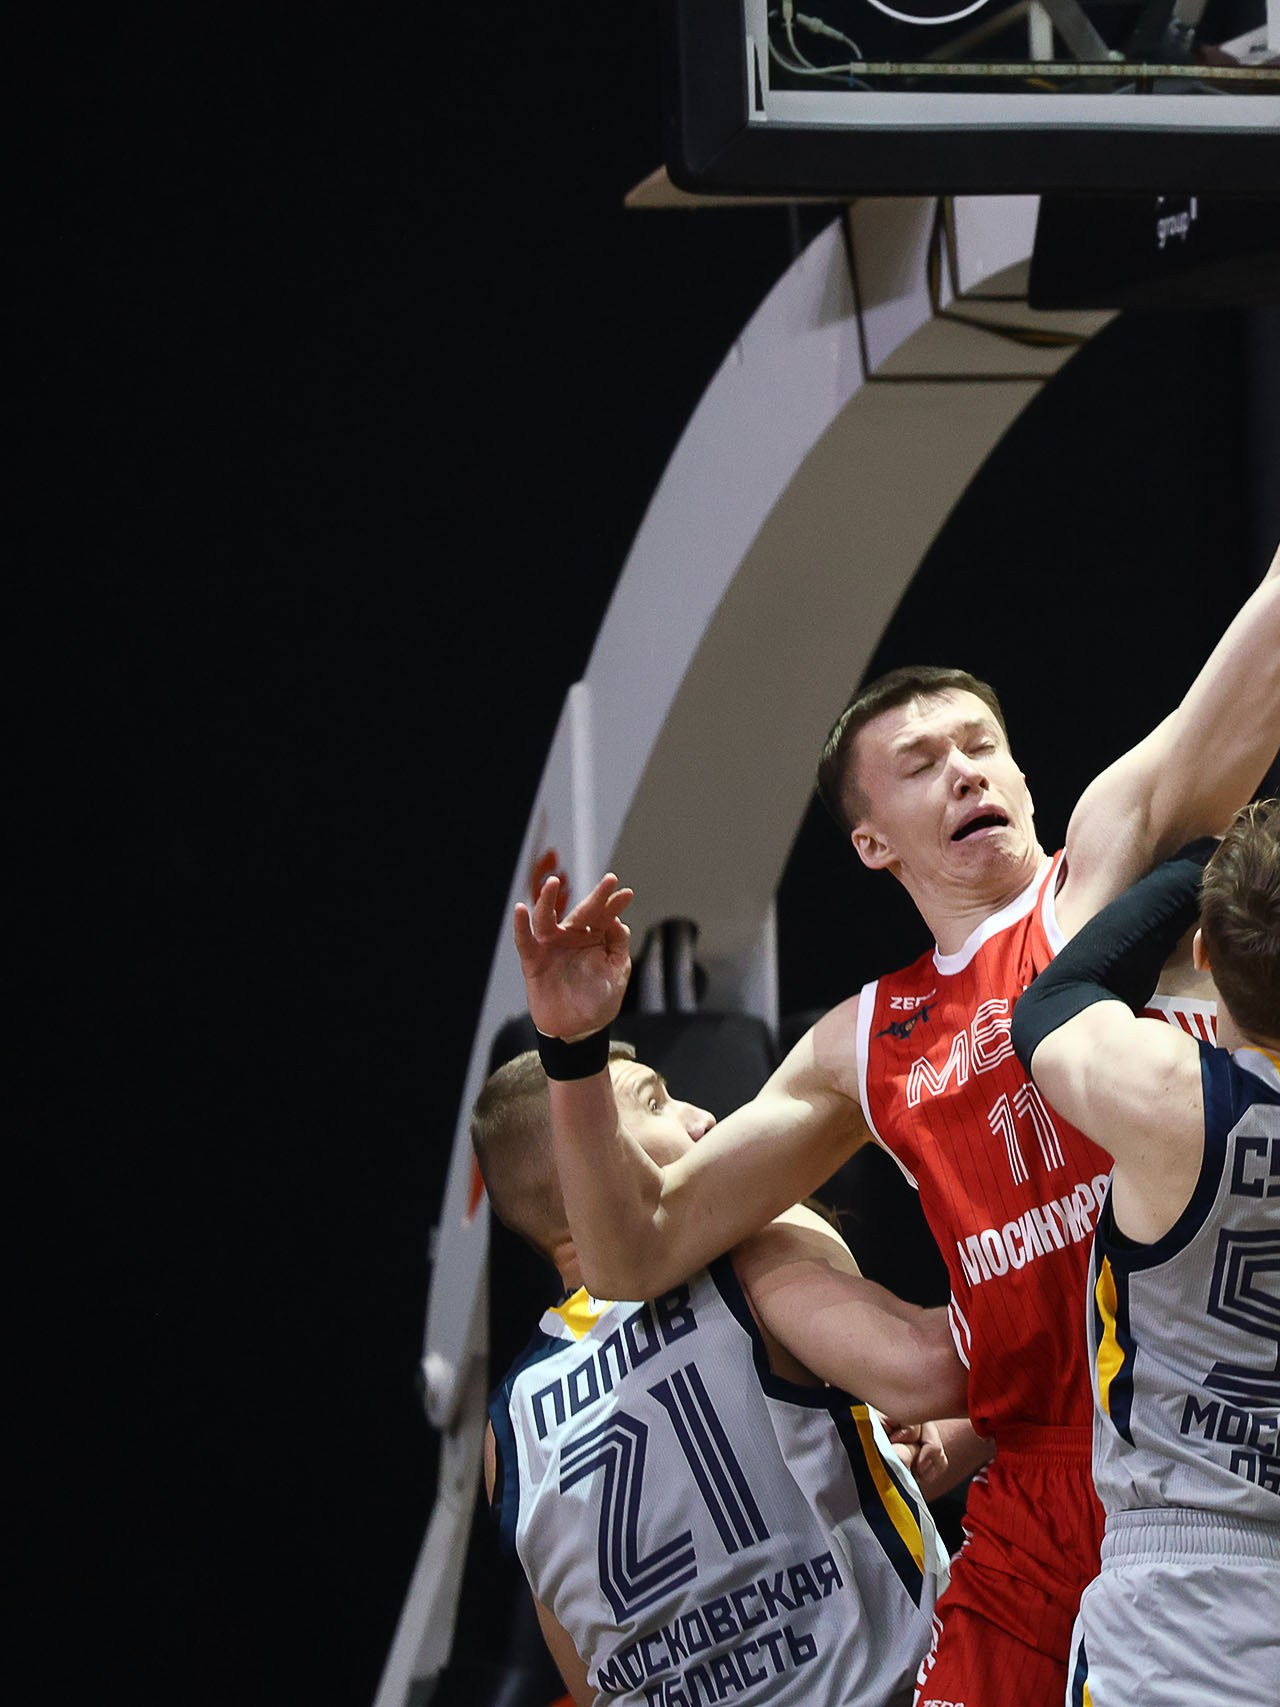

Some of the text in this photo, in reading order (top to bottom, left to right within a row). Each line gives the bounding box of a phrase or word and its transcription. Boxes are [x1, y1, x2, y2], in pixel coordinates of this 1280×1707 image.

[906, 998, 1015, 1109] МБ
[987, 1082, 1065, 1186] 11
[531, 1283, 698, 1441] ПОПОВ
[560, 1362, 769, 1624] 21
[597, 1551, 844, 1693] МОСКОВСКАЯ
